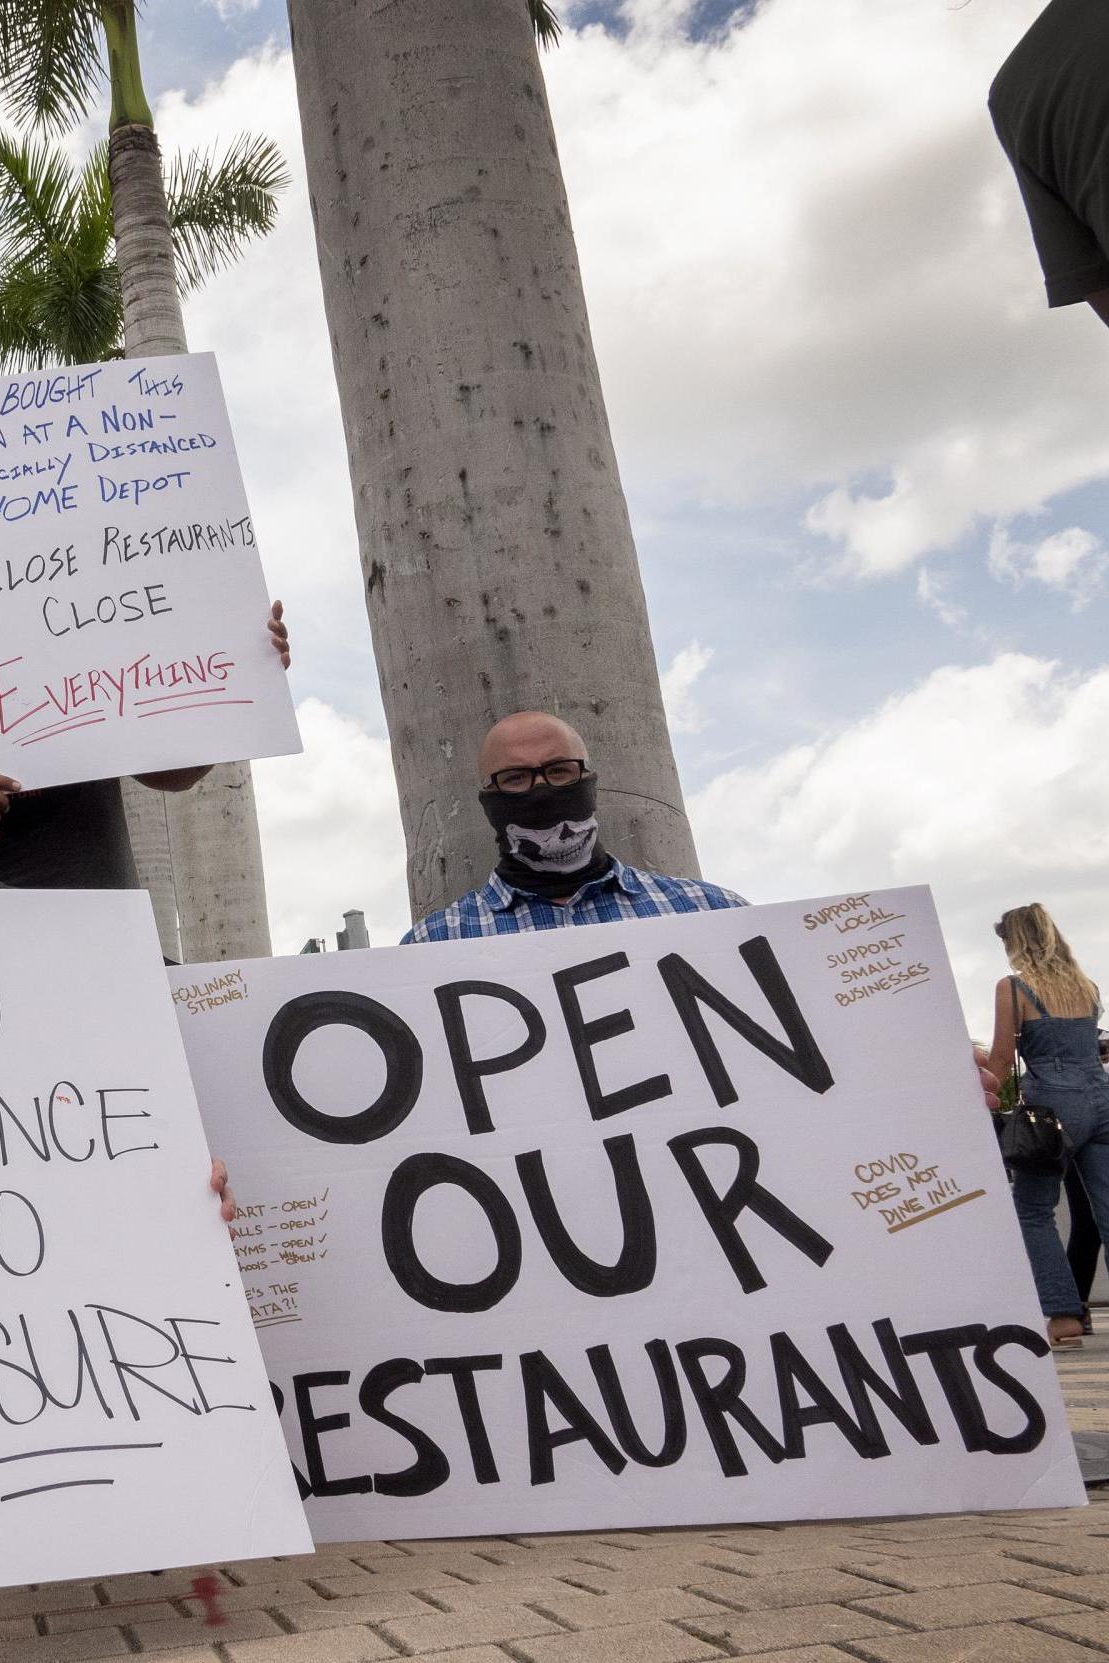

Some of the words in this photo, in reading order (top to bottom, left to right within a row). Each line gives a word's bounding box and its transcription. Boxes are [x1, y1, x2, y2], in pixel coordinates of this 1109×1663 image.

[0, 369, 102, 415] BOUGHT
[128, 368, 184, 398] THIS
[22, 423, 54, 443] AT
[66, 414, 88, 437] A
[101, 405, 177, 434] NON-
[88, 432, 217, 463] DISTANCED
[42, 584, 173, 637] CLOSE
[803, 894, 870, 931] SUPPORT
[835, 908, 894, 933] LOCAL
[827, 934, 905, 968] SUPPORT
[835, 963, 929, 1007] BUSINESSES
[841, 958, 901, 984] SMALL
[188, 984, 248, 1014] STRONG!
[262, 935, 835, 1145] OPEN
[855, 1153, 918, 1183] COVID
[851, 1182, 901, 1210] DOES
[906, 1165, 939, 1191] NOT
[878, 1198, 925, 1225] DINE
[927, 1178, 961, 1205] IN!!
[235, 1205, 265, 1220] ART
[282, 1197, 316, 1213] OPEN
[280, 1218, 315, 1230] OPEN
[381, 1126, 834, 1313] OUR
[282, 1236, 313, 1248] OPEN
[286, 1252, 315, 1265] OPEN
[269, 1283, 299, 1296] THE
[250, 1298, 298, 1318] ATA?!
